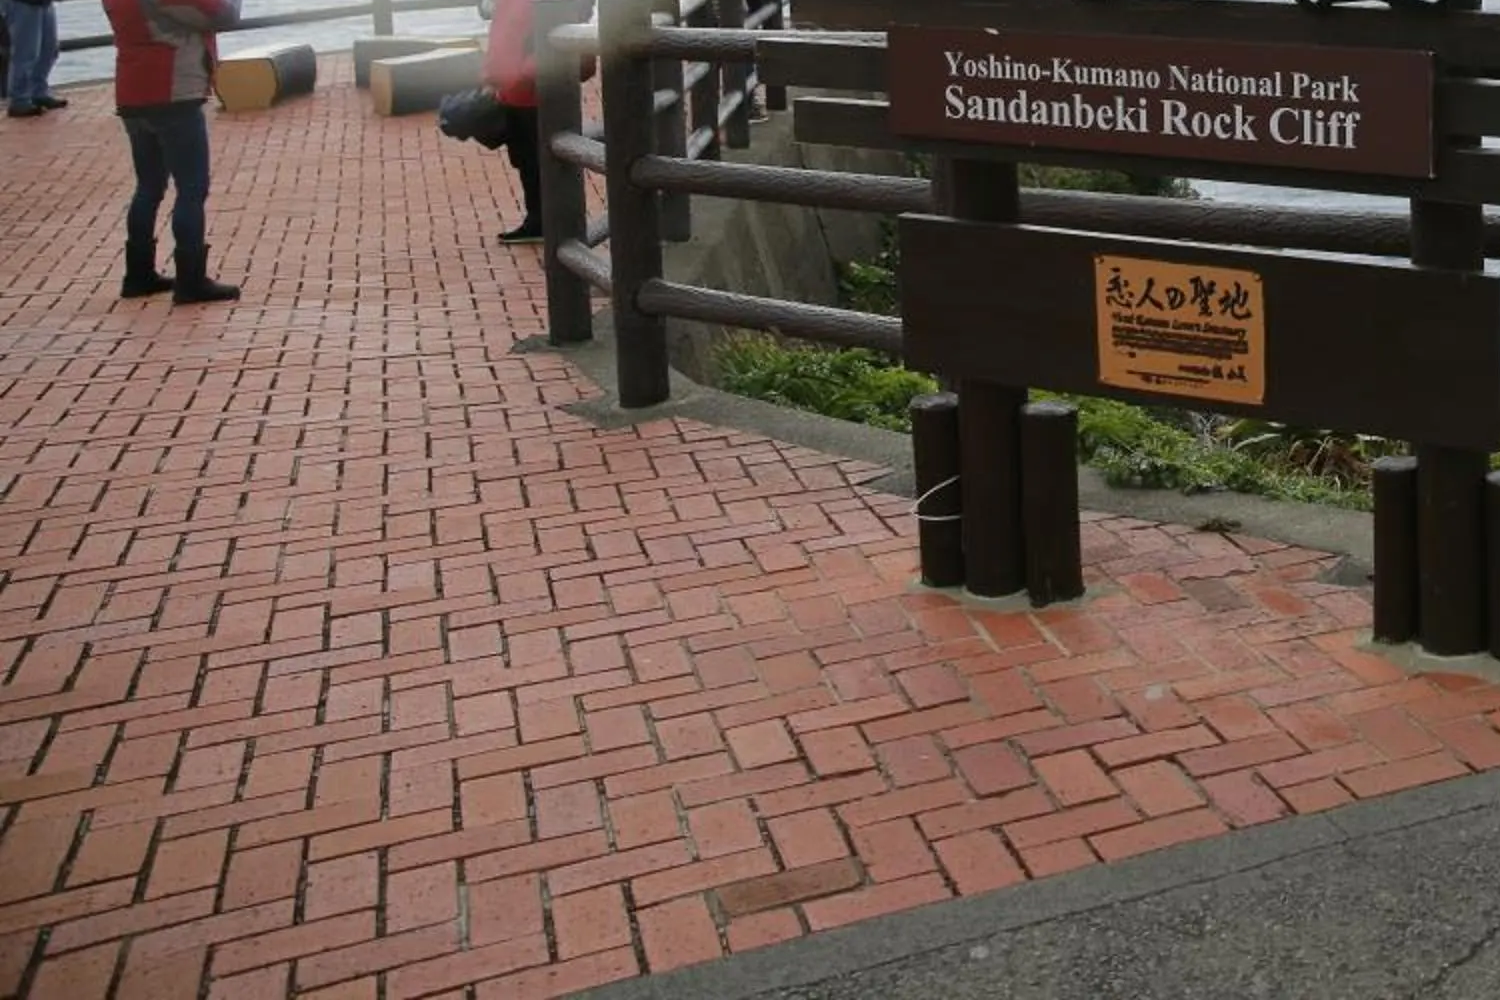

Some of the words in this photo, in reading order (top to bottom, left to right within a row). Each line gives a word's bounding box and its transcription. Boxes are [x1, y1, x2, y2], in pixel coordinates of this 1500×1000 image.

[944, 51, 1160, 89] Yoshino-Kumano
[1168, 65, 1283, 97] National
[1293, 72, 1360, 103] Park
[944, 85, 1148, 133] Sandanbeki
[1160, 99, 1257, 142] Rock
[1269, 107, 1361, 150] Cliff
[1106, 267, 1252, 320] 恋人の聖地
